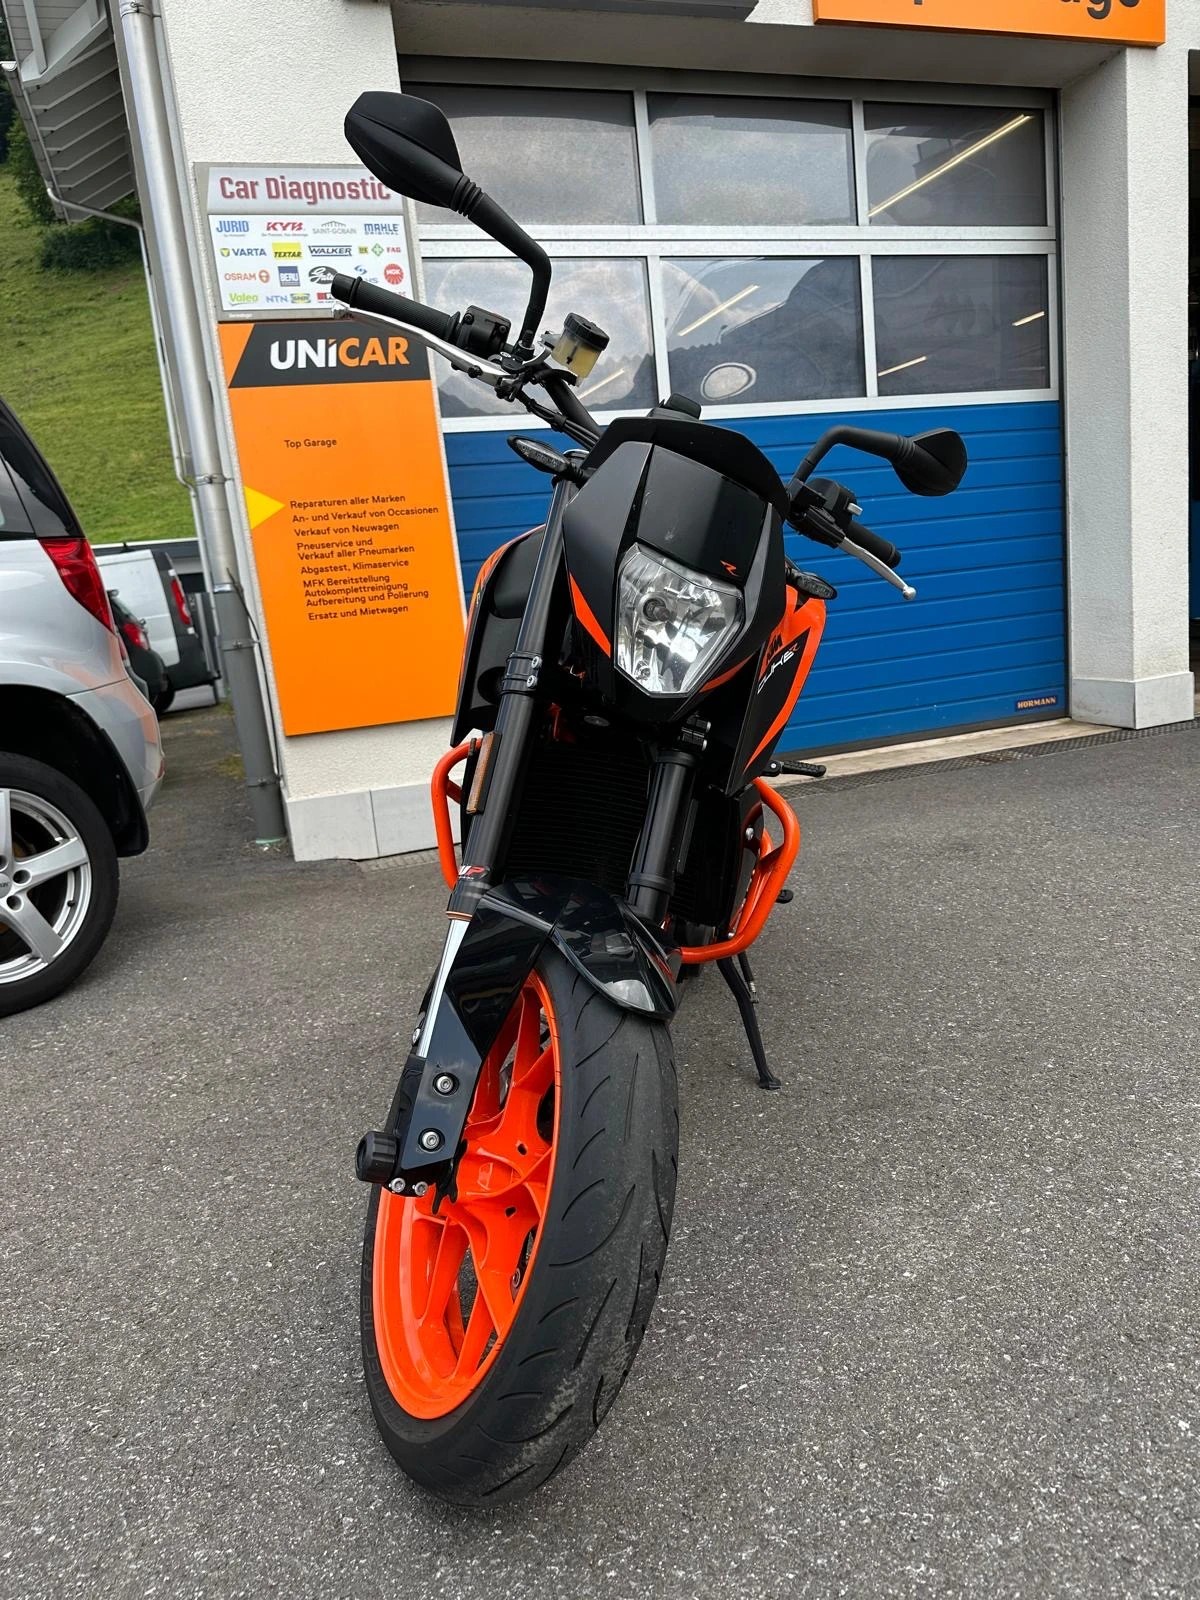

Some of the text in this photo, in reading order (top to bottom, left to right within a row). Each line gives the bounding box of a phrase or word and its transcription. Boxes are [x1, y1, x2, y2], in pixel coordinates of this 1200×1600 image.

[219, 175, 391, 205] Car Diagnostic
[216, 220, 250, 233] JURID
[266, 222, 303, 231] KYB
[364, 223, 399, 232] MAHLE
[232, 248, 267, 256] VARTA
[308, 247, 352, 255] WALKER
[224, 273, 257, 281] OSRAM
[229, 293, 258, 302] Valeo
[284, 438, 337, 448] Top Garage
[290, 495, 405, 510] Reparaturen aller Marken
[292, 506, 438, 523] An- und Verkauf von Occasionen
[294, 527, 330, 537] Verkauf
[352, 523, 400, 534] Neuwagen
[297, 538, 373, 551] Pneuservice und
[298, 545, 415, 561] Verkauf aller Pneumarken
[301, 559, 409, 575] Abgastest, Klimaservice
[303, 575, 390, 588] MFK Bereitstellung
[304, 583, 408, 598] Autokomplettreinigung
[306, 589, 429, 607] Aufbereitung und Polierung
[308, 605, 408, 621] Ersatz und Mietwagen
